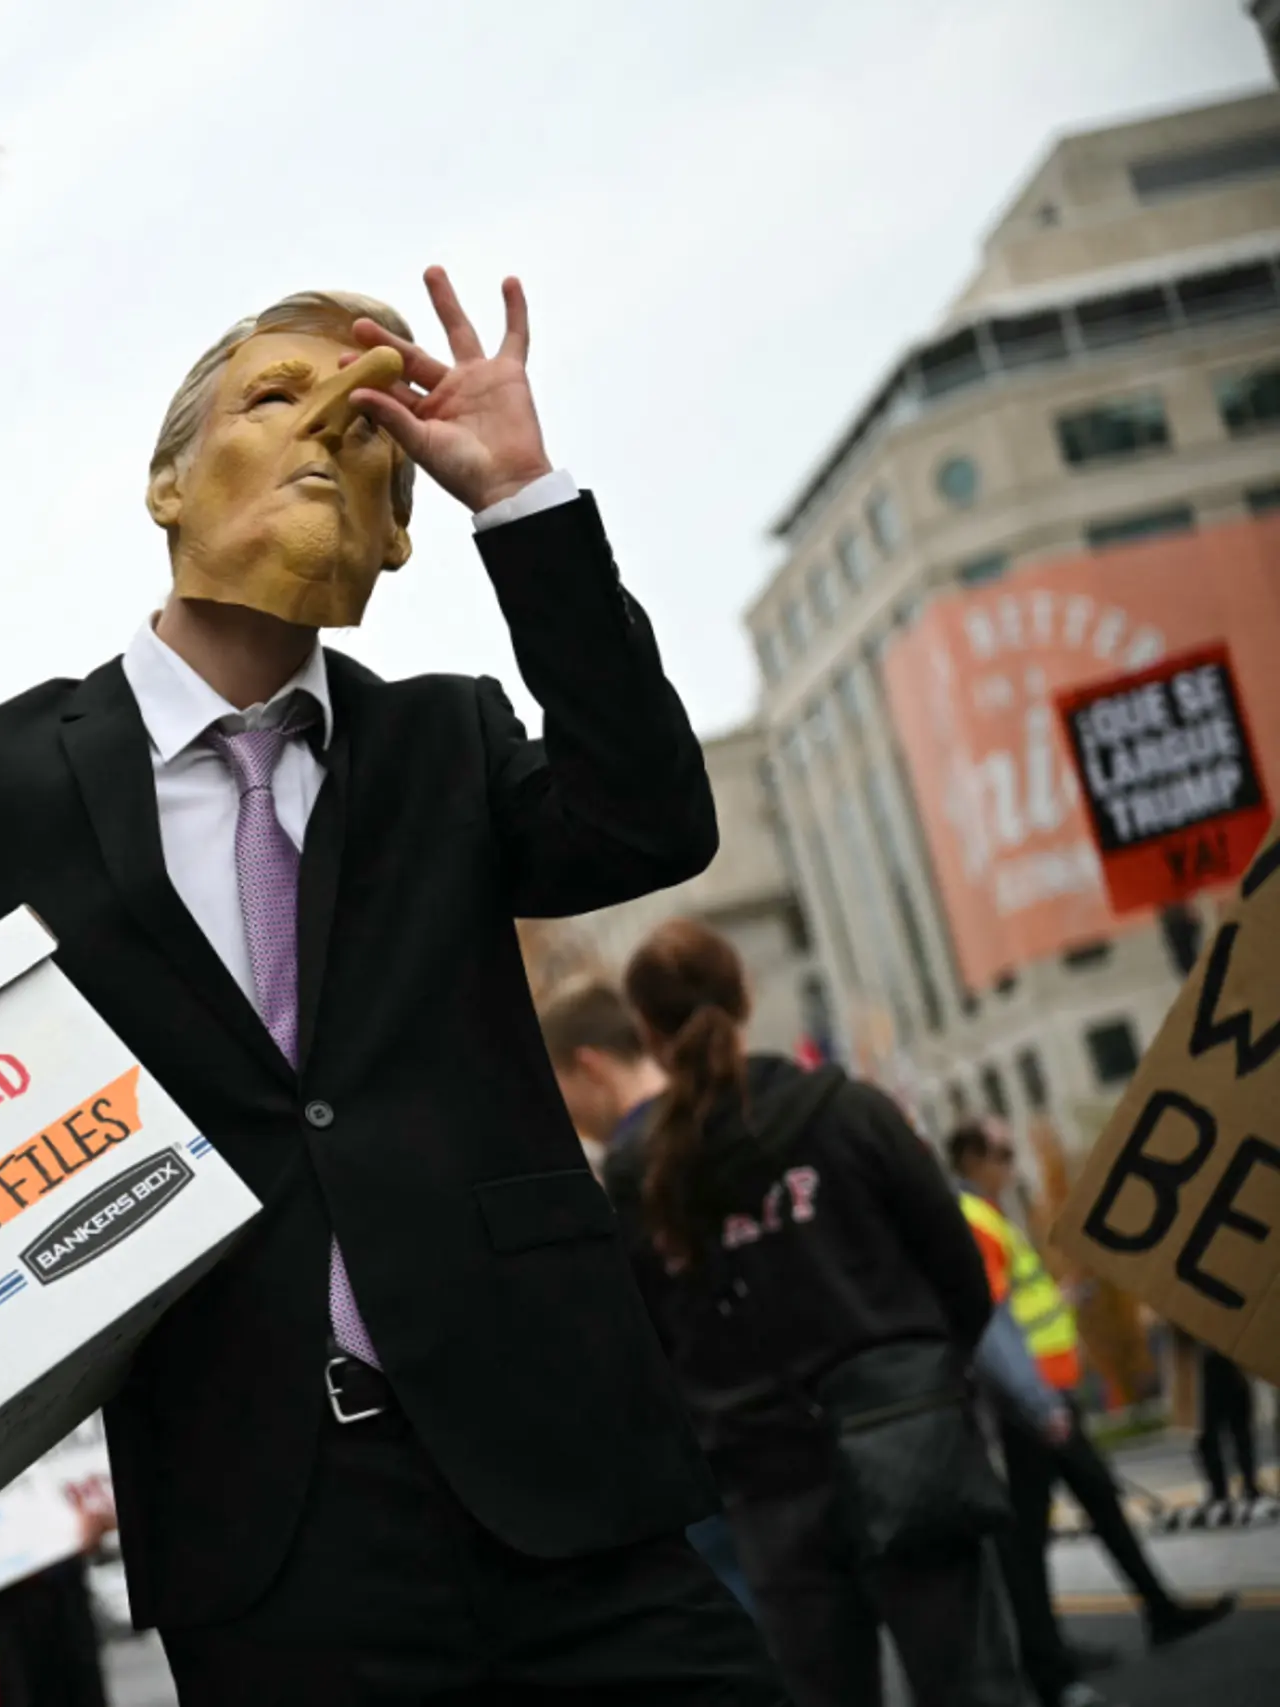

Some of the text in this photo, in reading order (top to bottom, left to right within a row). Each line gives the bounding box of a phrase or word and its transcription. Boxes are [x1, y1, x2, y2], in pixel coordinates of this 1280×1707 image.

[1171, 663, 1224, 720] SE
[1083, 716, 1239, 798] LARGUE
[1106, 762, 1242, 842] TRUMP
[35, 1161, 180, 1270] BANKERS BOX
